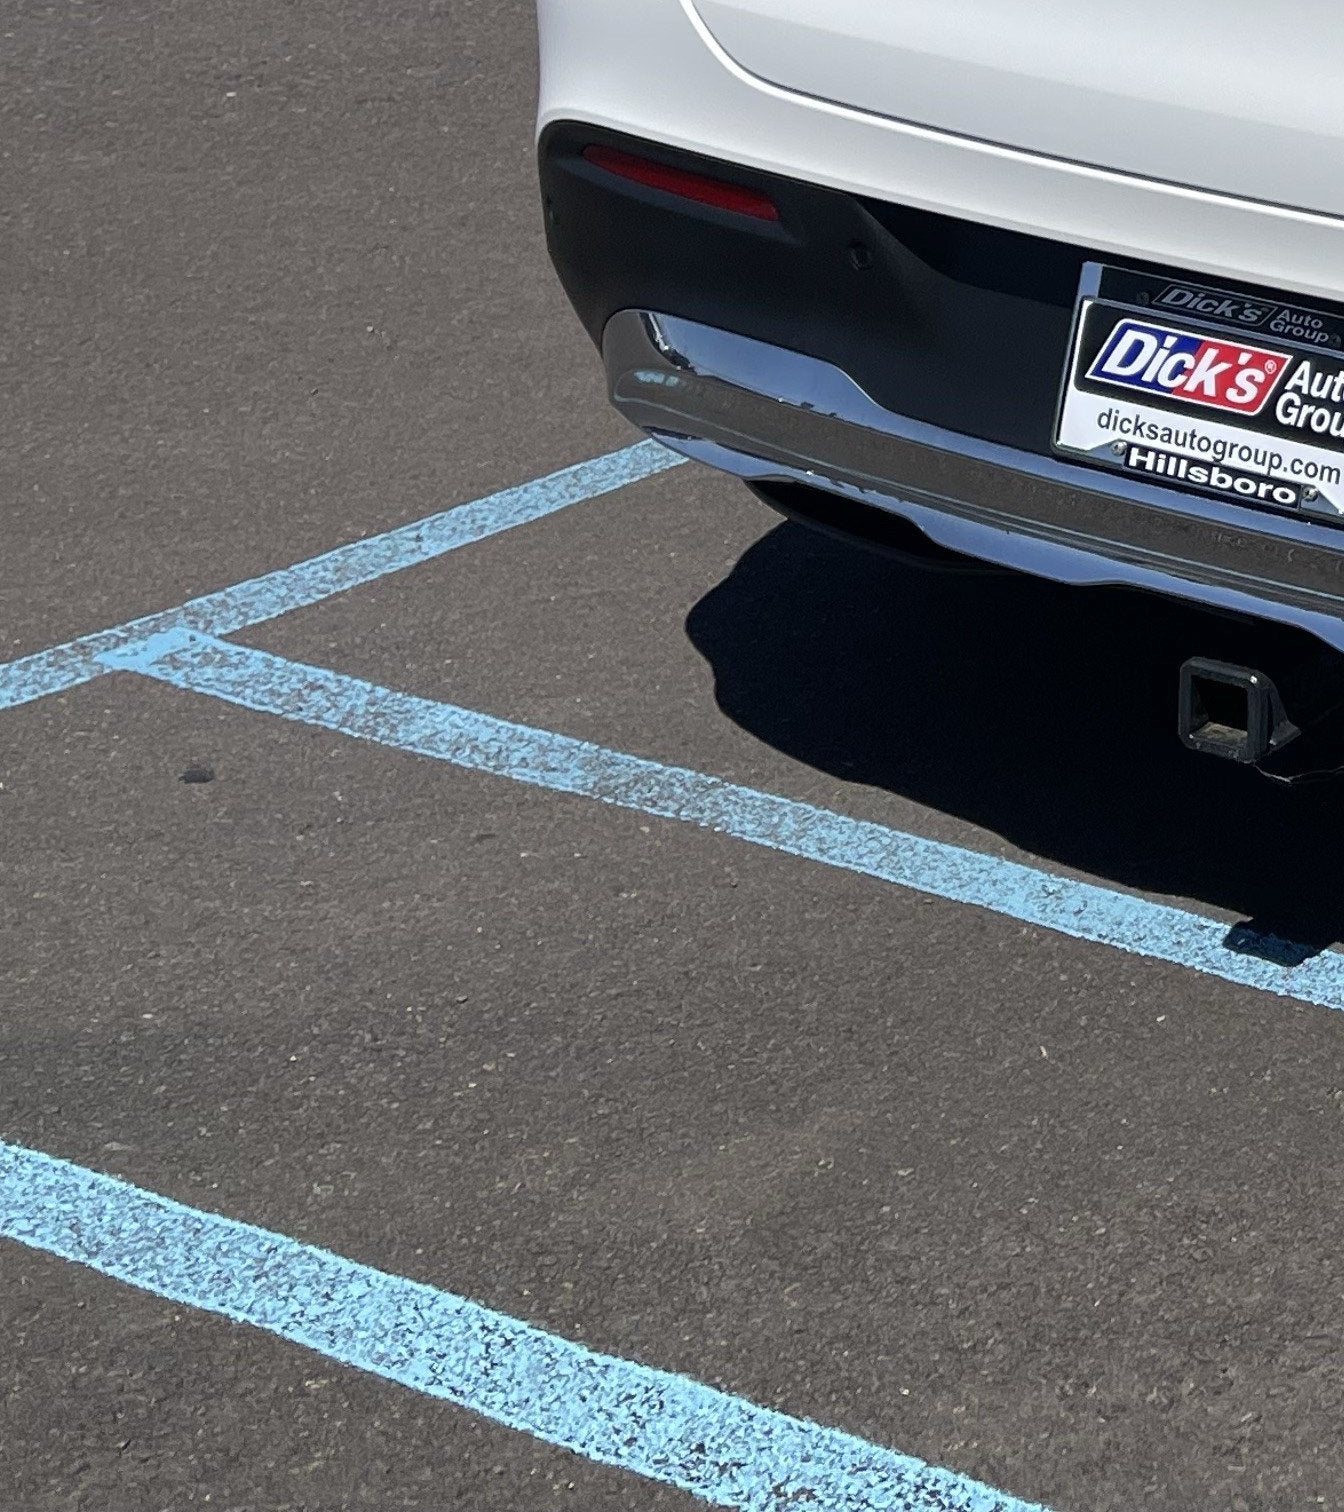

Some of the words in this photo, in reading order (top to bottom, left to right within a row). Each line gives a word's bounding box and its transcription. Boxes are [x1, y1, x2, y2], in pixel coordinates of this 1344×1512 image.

[1160, 288, 1264, 324] Dick's
[1275, 307, 1325, 330] Auto
[1268, 318, 1331, 345] Group
[1101, 329, 1266, 405] Dick's
[1096, 407, 1342, 485] dicksautogroup.com
[1127, 446, 1297, 505] Hillsboro
